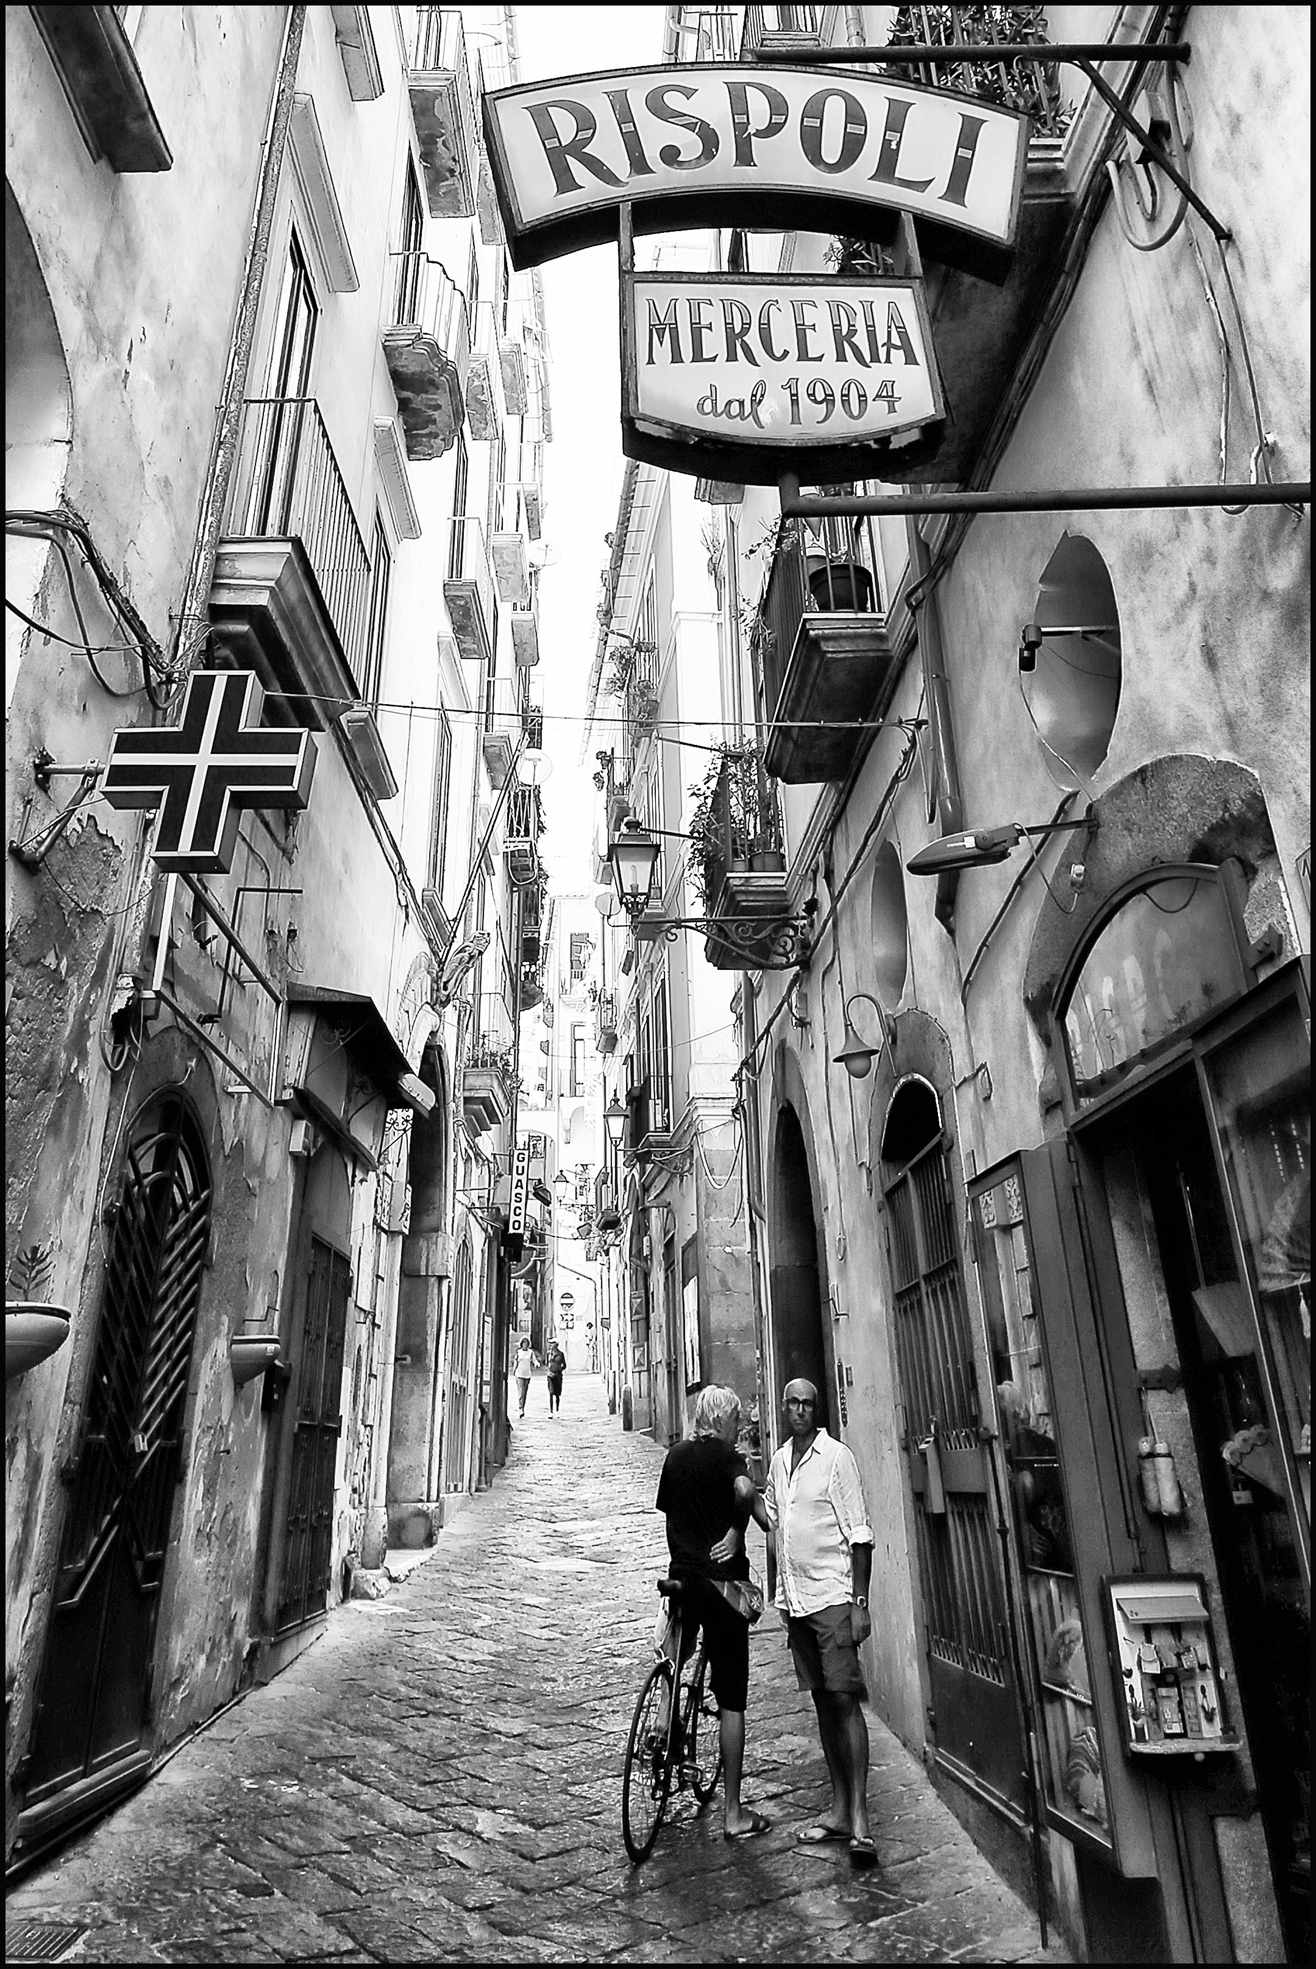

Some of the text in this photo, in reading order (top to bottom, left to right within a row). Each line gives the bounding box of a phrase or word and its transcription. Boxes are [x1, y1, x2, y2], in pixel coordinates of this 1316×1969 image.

[522, 81, 989, 207] RISPOLI
[645, 298, 921, 368] MERCERIA
[696, 377, 902, 429] dal 1904
[512, 1152, 526, 1231] GUASCO
